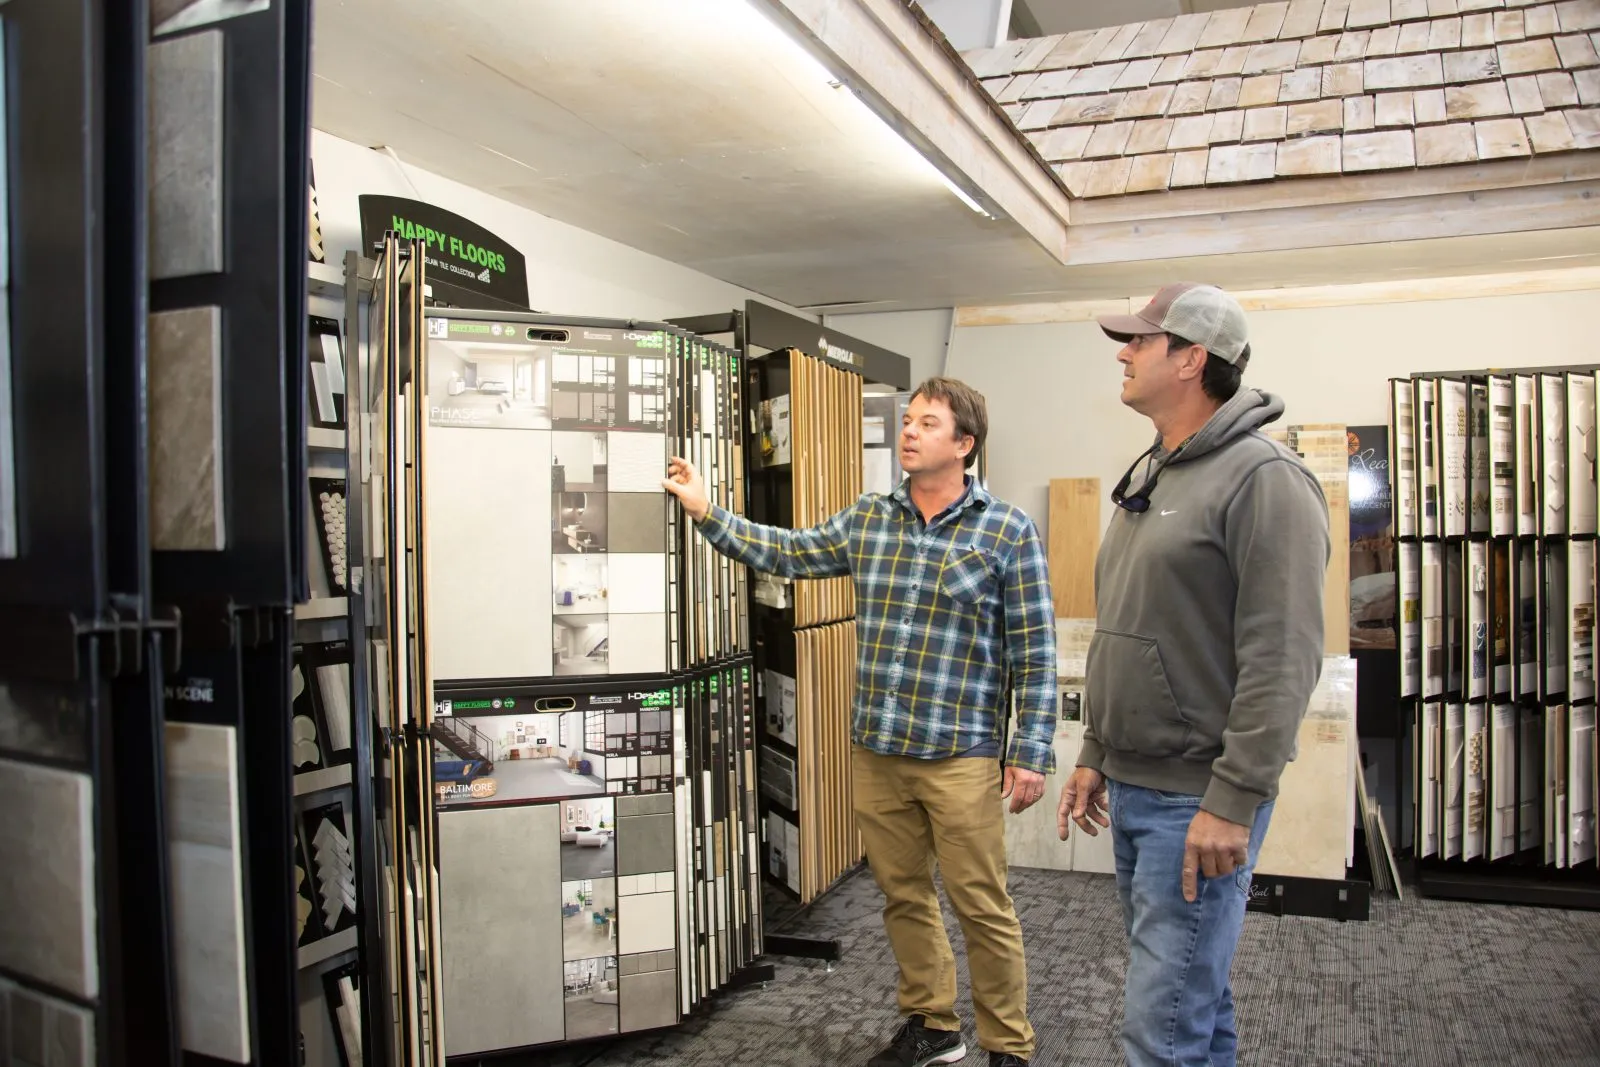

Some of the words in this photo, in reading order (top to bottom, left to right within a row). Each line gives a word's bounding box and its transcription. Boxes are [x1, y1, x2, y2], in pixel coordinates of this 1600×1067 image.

[392, 215, 446, 252] HAPPY
[450, 237, 505, 273] FLOORS
[440, 261, 449, 270] TILE
[450, 264, 476, 279] COLLECTION
[627, 691, 671, 701] I-Design
[435, 700, 450, 714] HF
[440, 782, 493, 795] BALTIMORE
